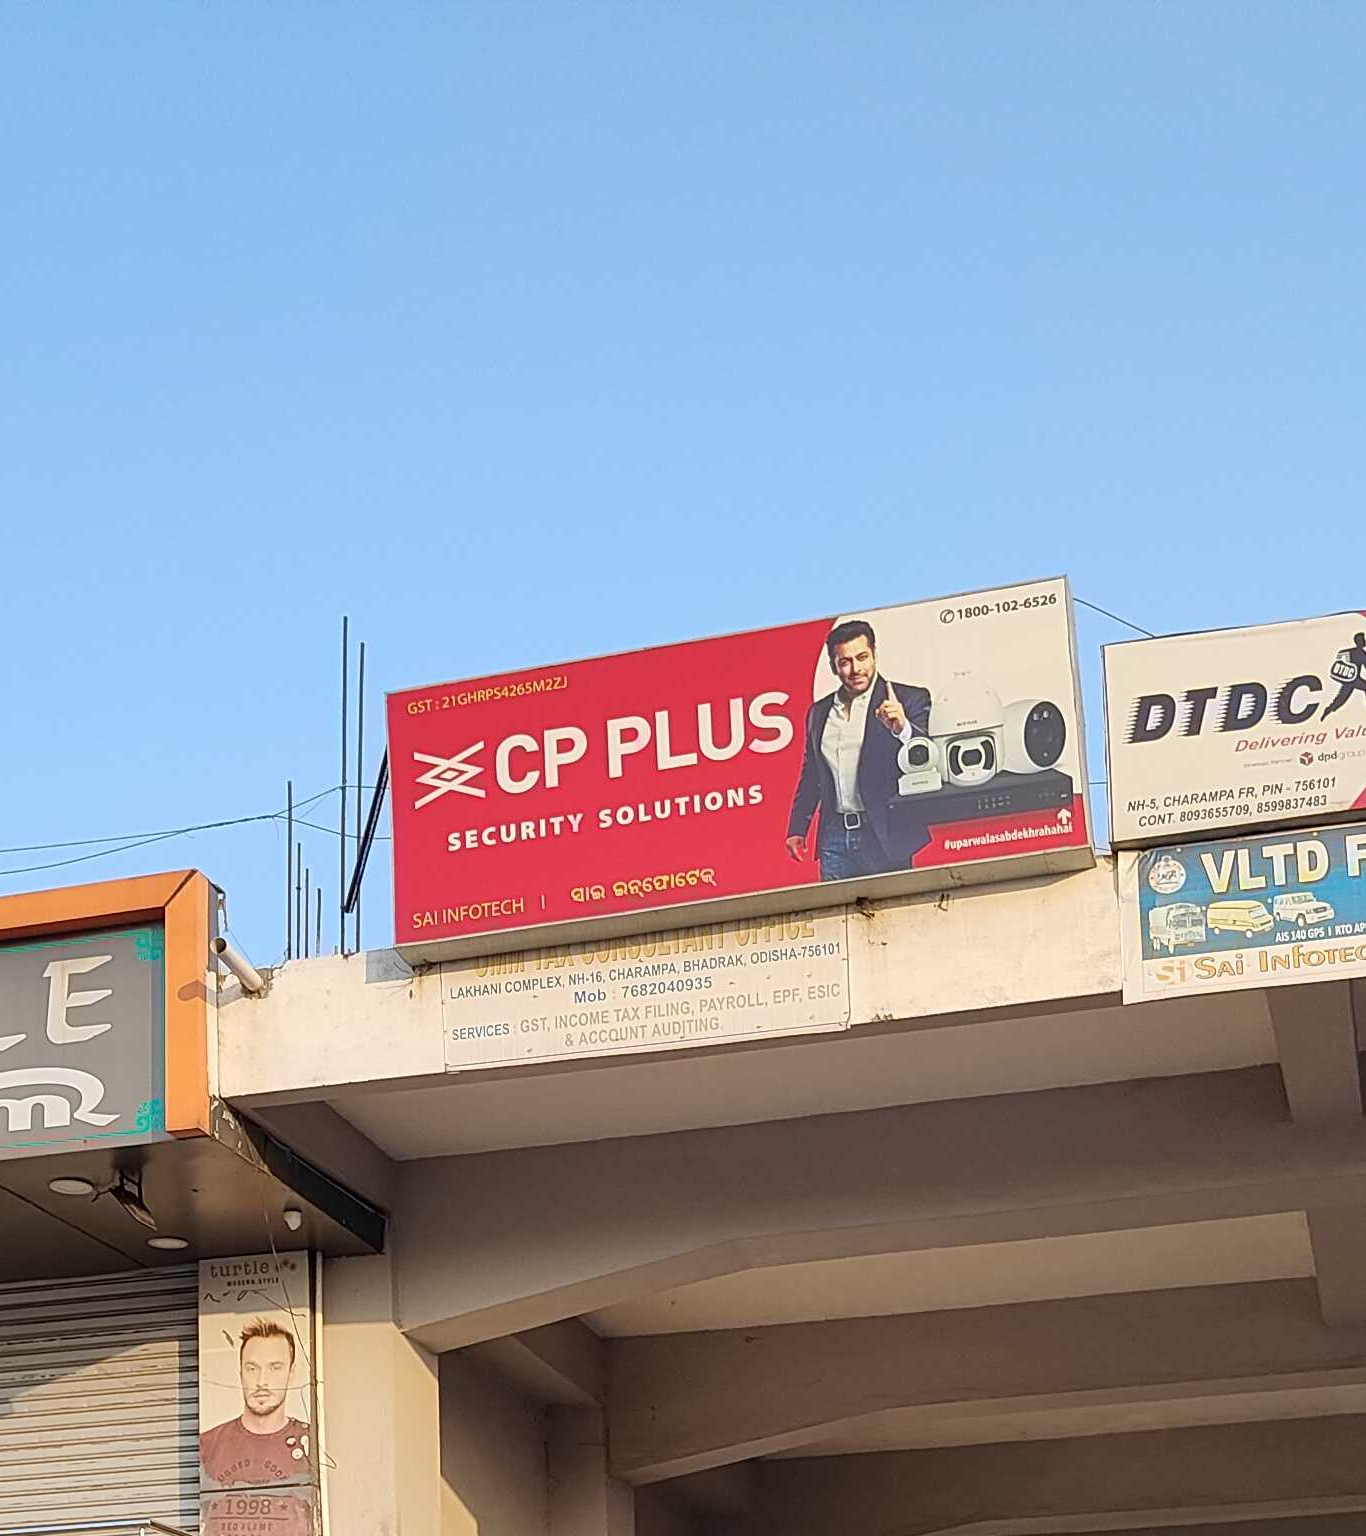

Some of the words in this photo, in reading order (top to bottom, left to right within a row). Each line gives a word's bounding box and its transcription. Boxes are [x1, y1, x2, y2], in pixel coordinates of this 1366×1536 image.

[957, 593, 1057, 620] 1800-102-6526
[1122, 674, 1324, 745] DTDC
[494, 725, 588, 796] CP
[606, 689, 794, 779] PLUS
[1234, 730, 1327, 754] Delivering
[1163, 790, 1235, 808] CHARAMPA
[1262, 783, 1283, 796] PIN
[1294, 776, 1336, 793] 756101
[446, 811, 584, 852] SECURITY
[598, 783, 765, 829] SOLUTIONS
[1200, 839, 1330, 895] VLTD
[412, 910, 442, 930] SAI
[443, 895, 526, 926] INFOTECH
[450, 983, 501, 999] LAKHANI
[504, 976, 565, 993] COMPLEX,
[574, 989, 606, 1004] Mob
[808, 983, 841, 999] ESIC
[452, 1023, 510, 1040] SERVICES
[555, 1011, 609, 1030] INCOME
[614, 1007, 641, 1022] TAX
[564, 1034, 574, 1047] &
[579, 1025, 647, 1045] ACCOUNT
[210, 1261, 269, 1278] turtle
[225, 1499, 271, 1515] 1998
